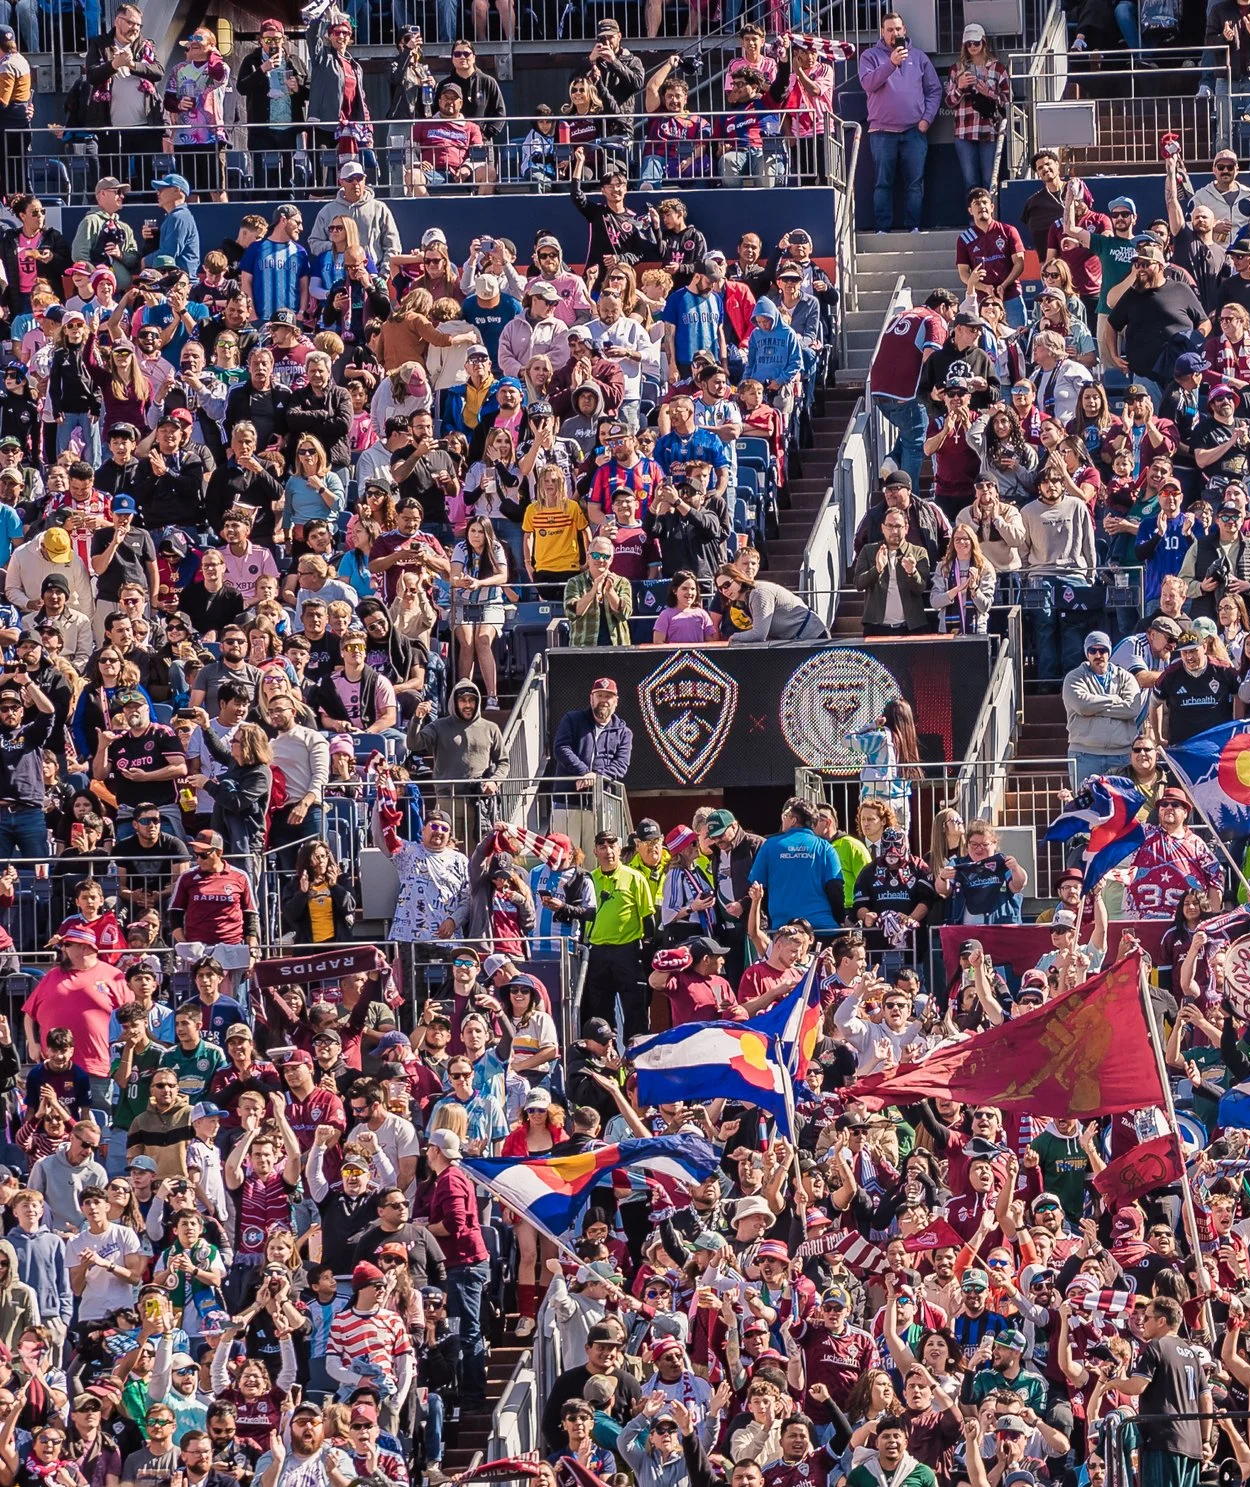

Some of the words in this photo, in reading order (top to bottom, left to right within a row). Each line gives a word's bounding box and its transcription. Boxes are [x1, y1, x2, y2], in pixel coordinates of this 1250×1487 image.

[1164, 535, 1180, 551] 10
[615, 544, 643, 555] chealth
[1181, 696, 1217, 706] uchealth
[131, 756, 153, 767] XBTO
[968, 876, 1002, 888] uchealth
[193, 893, 235, 903] RAPIDS
[877, 890, 911, 901] uchealth
[280, 956, 355, 976] RAPIDS
[127, 1083, 139, 1100] 10
[822, 1353, 858, 1368] uchealth
